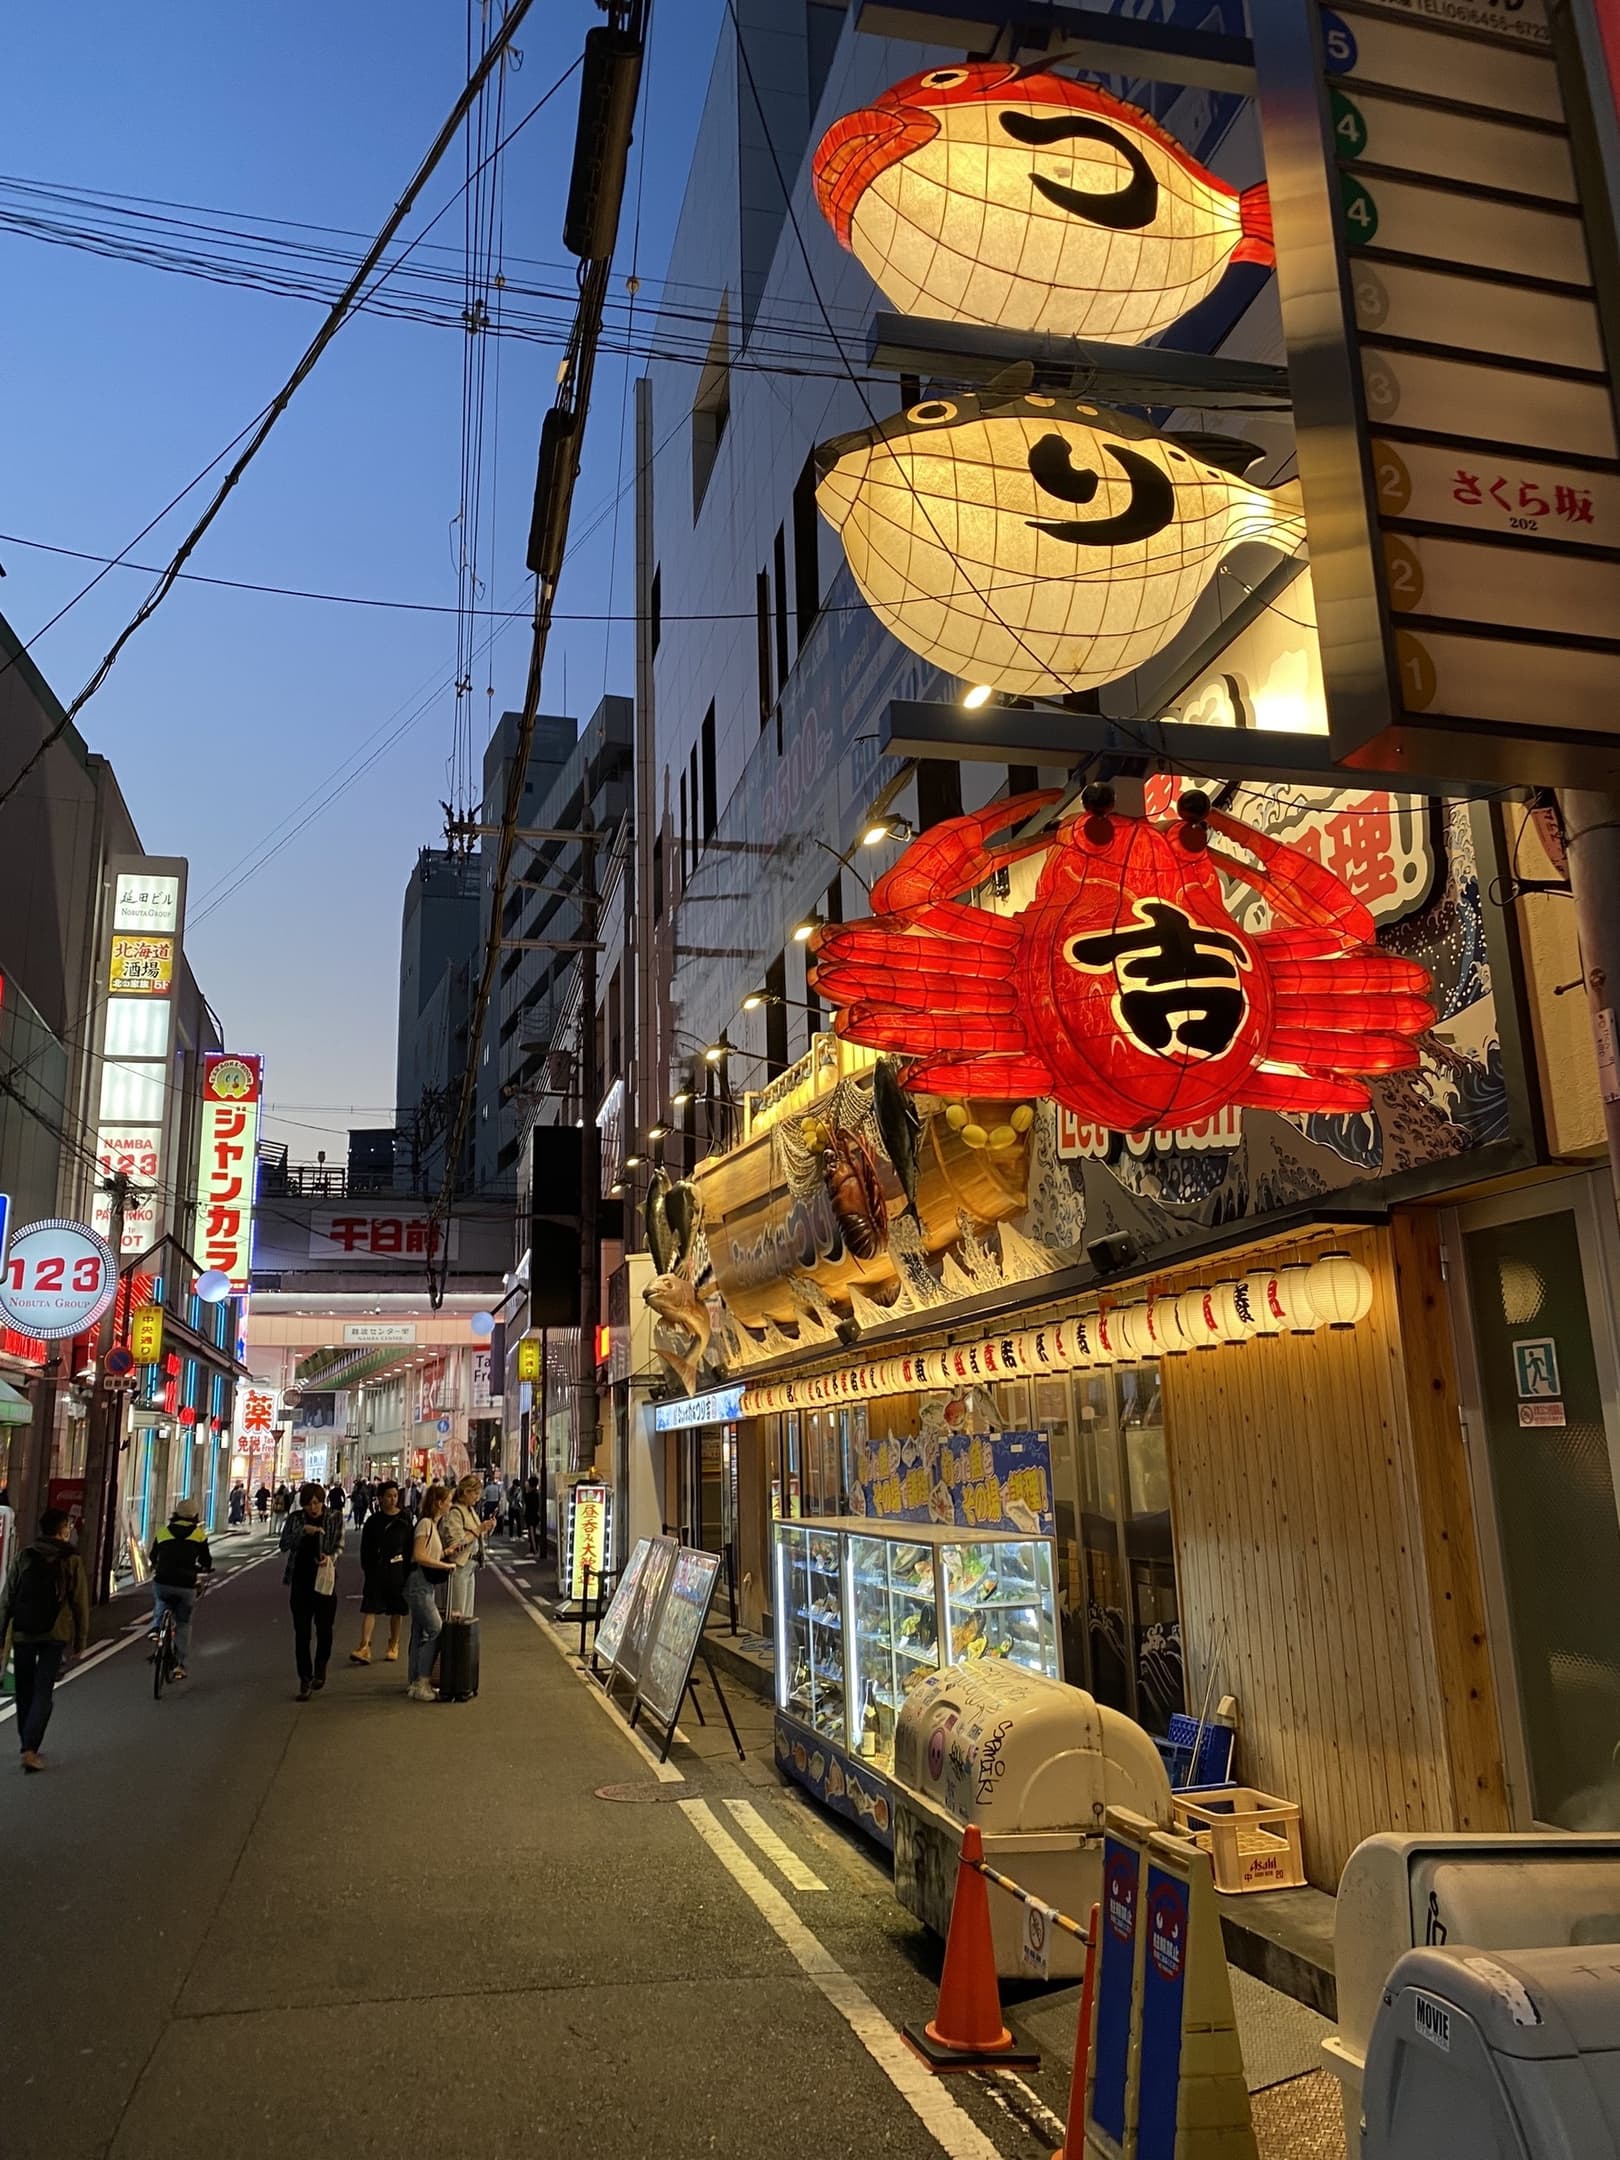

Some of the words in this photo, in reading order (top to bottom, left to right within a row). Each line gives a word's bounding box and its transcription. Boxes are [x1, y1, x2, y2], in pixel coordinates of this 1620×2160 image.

[1328, 30, 1349, 59] 5
[1337, 112, 1361, 142] 4
[1347, 197, 1371, 227] 4
[1359, 284, 1382, 315] 3
[1369, 371, 1393, 405] 3
[1380, 465, 1403, 496] 2
[1452, 469, 1595, 524] さくら坂
[1508, 517, 1539, 531] 202
[1391, 560, 1417, 592] 2
[1407, 658, 1422, 690] 1
[120, 891, 174, 905] 延田ビル
[115, 942, 170, 960] 北海道
[123, 961, 161, 978] 酒場
[154, 979, 171, 990] 5F
[1072, 902, 1249, 1059] 吉
[103, 1139, 153, 1149] NAMBA
[99, 1153, 158, 1175] 123
[206, 1106, 247, 1273] ジャンカラ
[330, 1217, 441, 1253] 千日前
[7, 1256, 100, 1292] 123
[9, 1296, 51, 1308] NOBUTA
[55, 1298, 91, 1309] GROUP
[140, 1316, 155, 1355] 中央通り
[475, 1354, 491, 1368] Ta
[244, 1388, 273, 1432] 薬
[1250, 1856, 1277, 1871] Asahi
[1417, 1997, 1448, 2041] MOVIE
